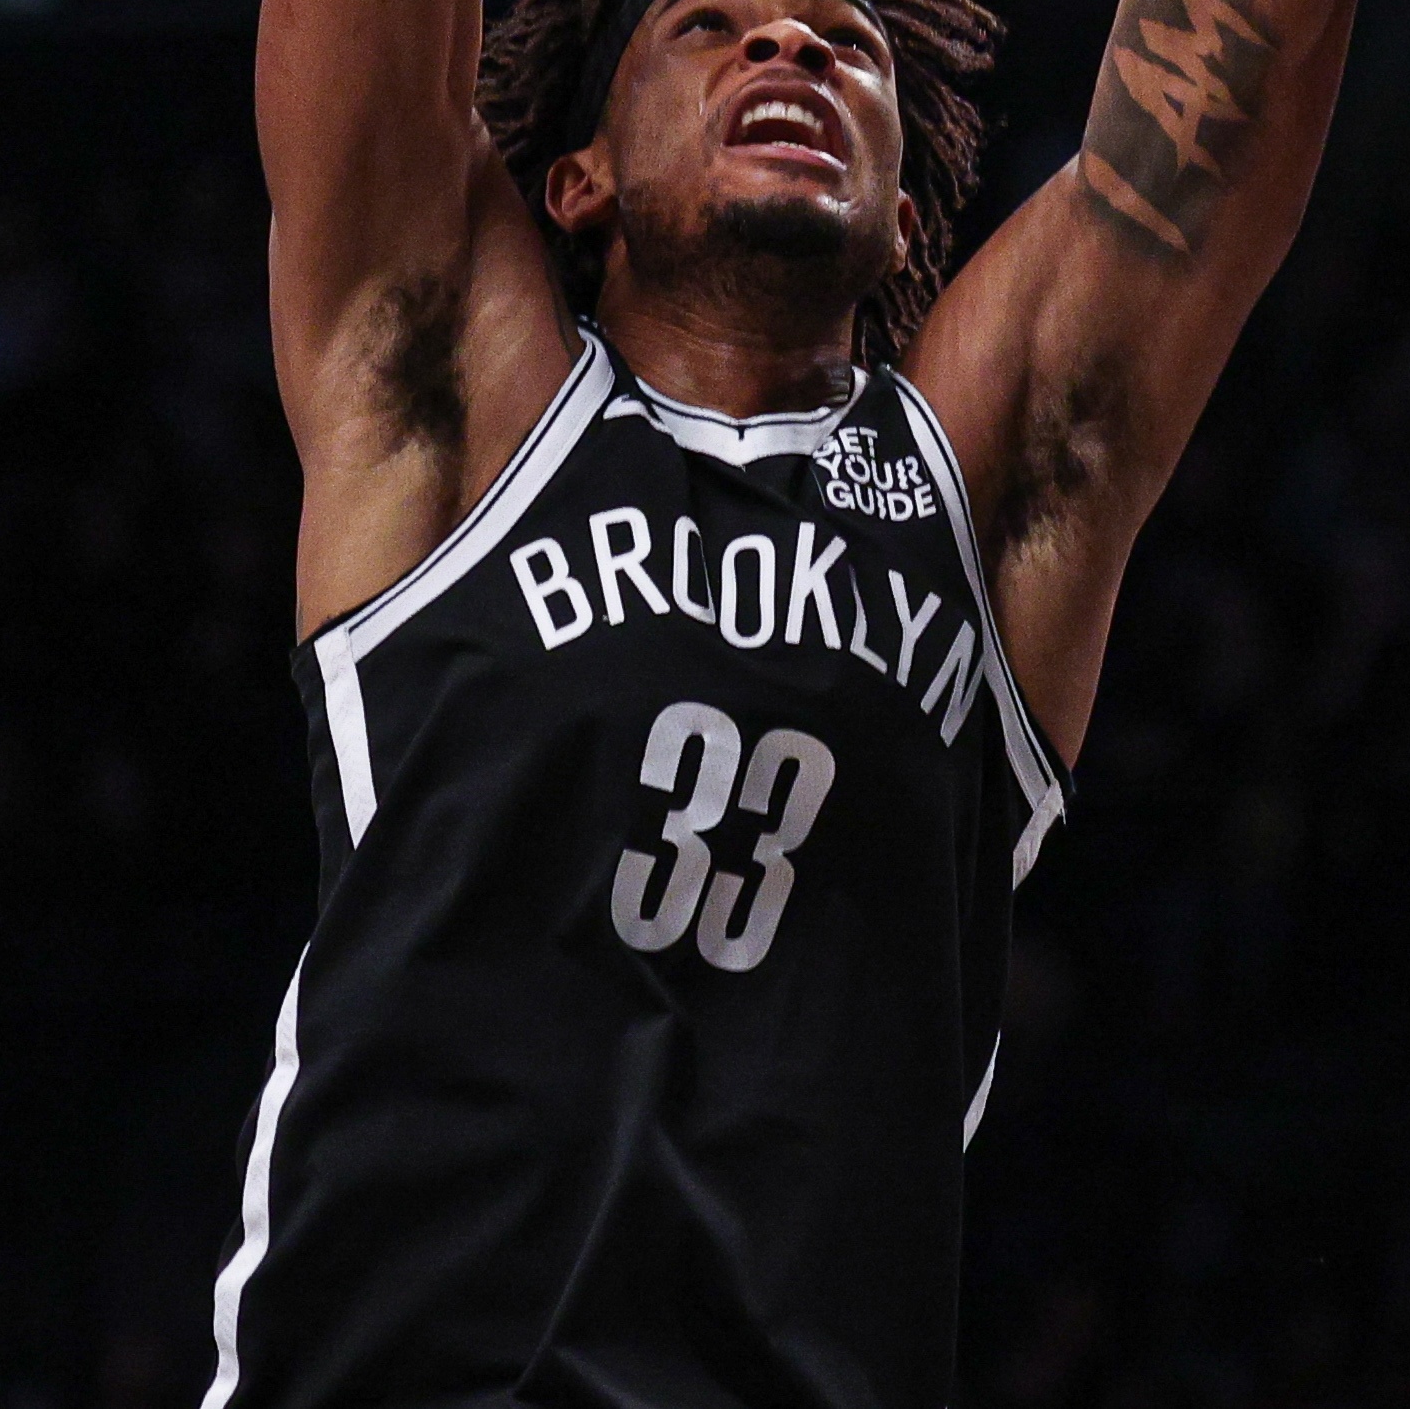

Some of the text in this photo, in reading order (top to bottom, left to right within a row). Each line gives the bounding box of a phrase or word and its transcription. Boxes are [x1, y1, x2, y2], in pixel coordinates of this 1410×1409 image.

[815, 454, 923, 491] YOUR
[826, 480, 937, 522] GUIDE
[509, 506, 985, 748] BROOKLYN
[610, 701, 836, 973] 33
